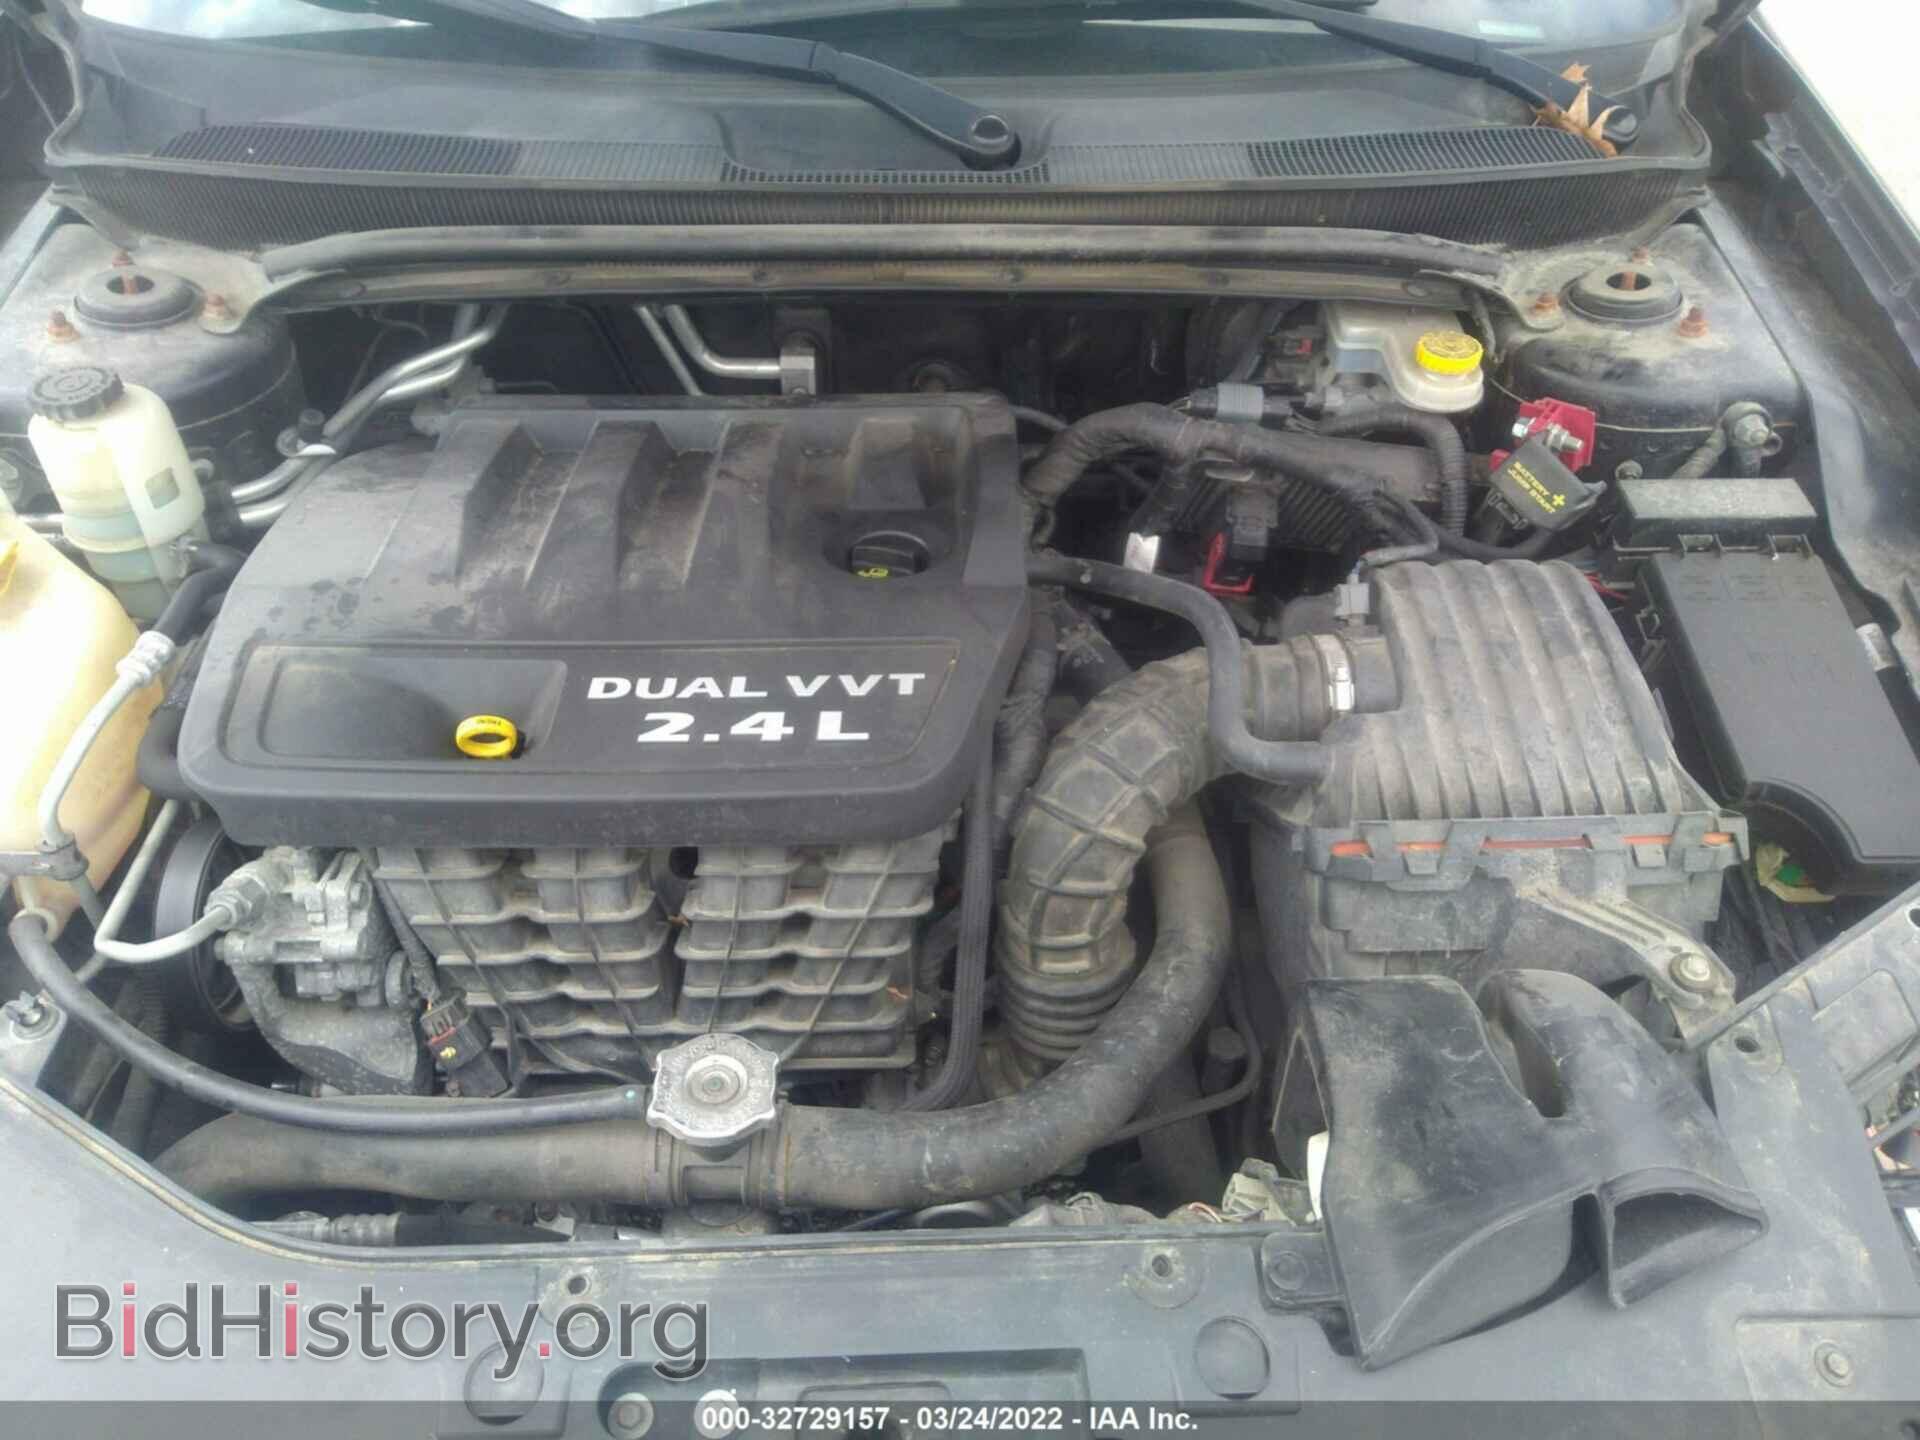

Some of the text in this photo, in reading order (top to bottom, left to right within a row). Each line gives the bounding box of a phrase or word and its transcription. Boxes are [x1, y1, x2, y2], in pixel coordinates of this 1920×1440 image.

[587, 673, 926, 699] DUAL VVT
[637, 710, 870, 742] 2.4 L
